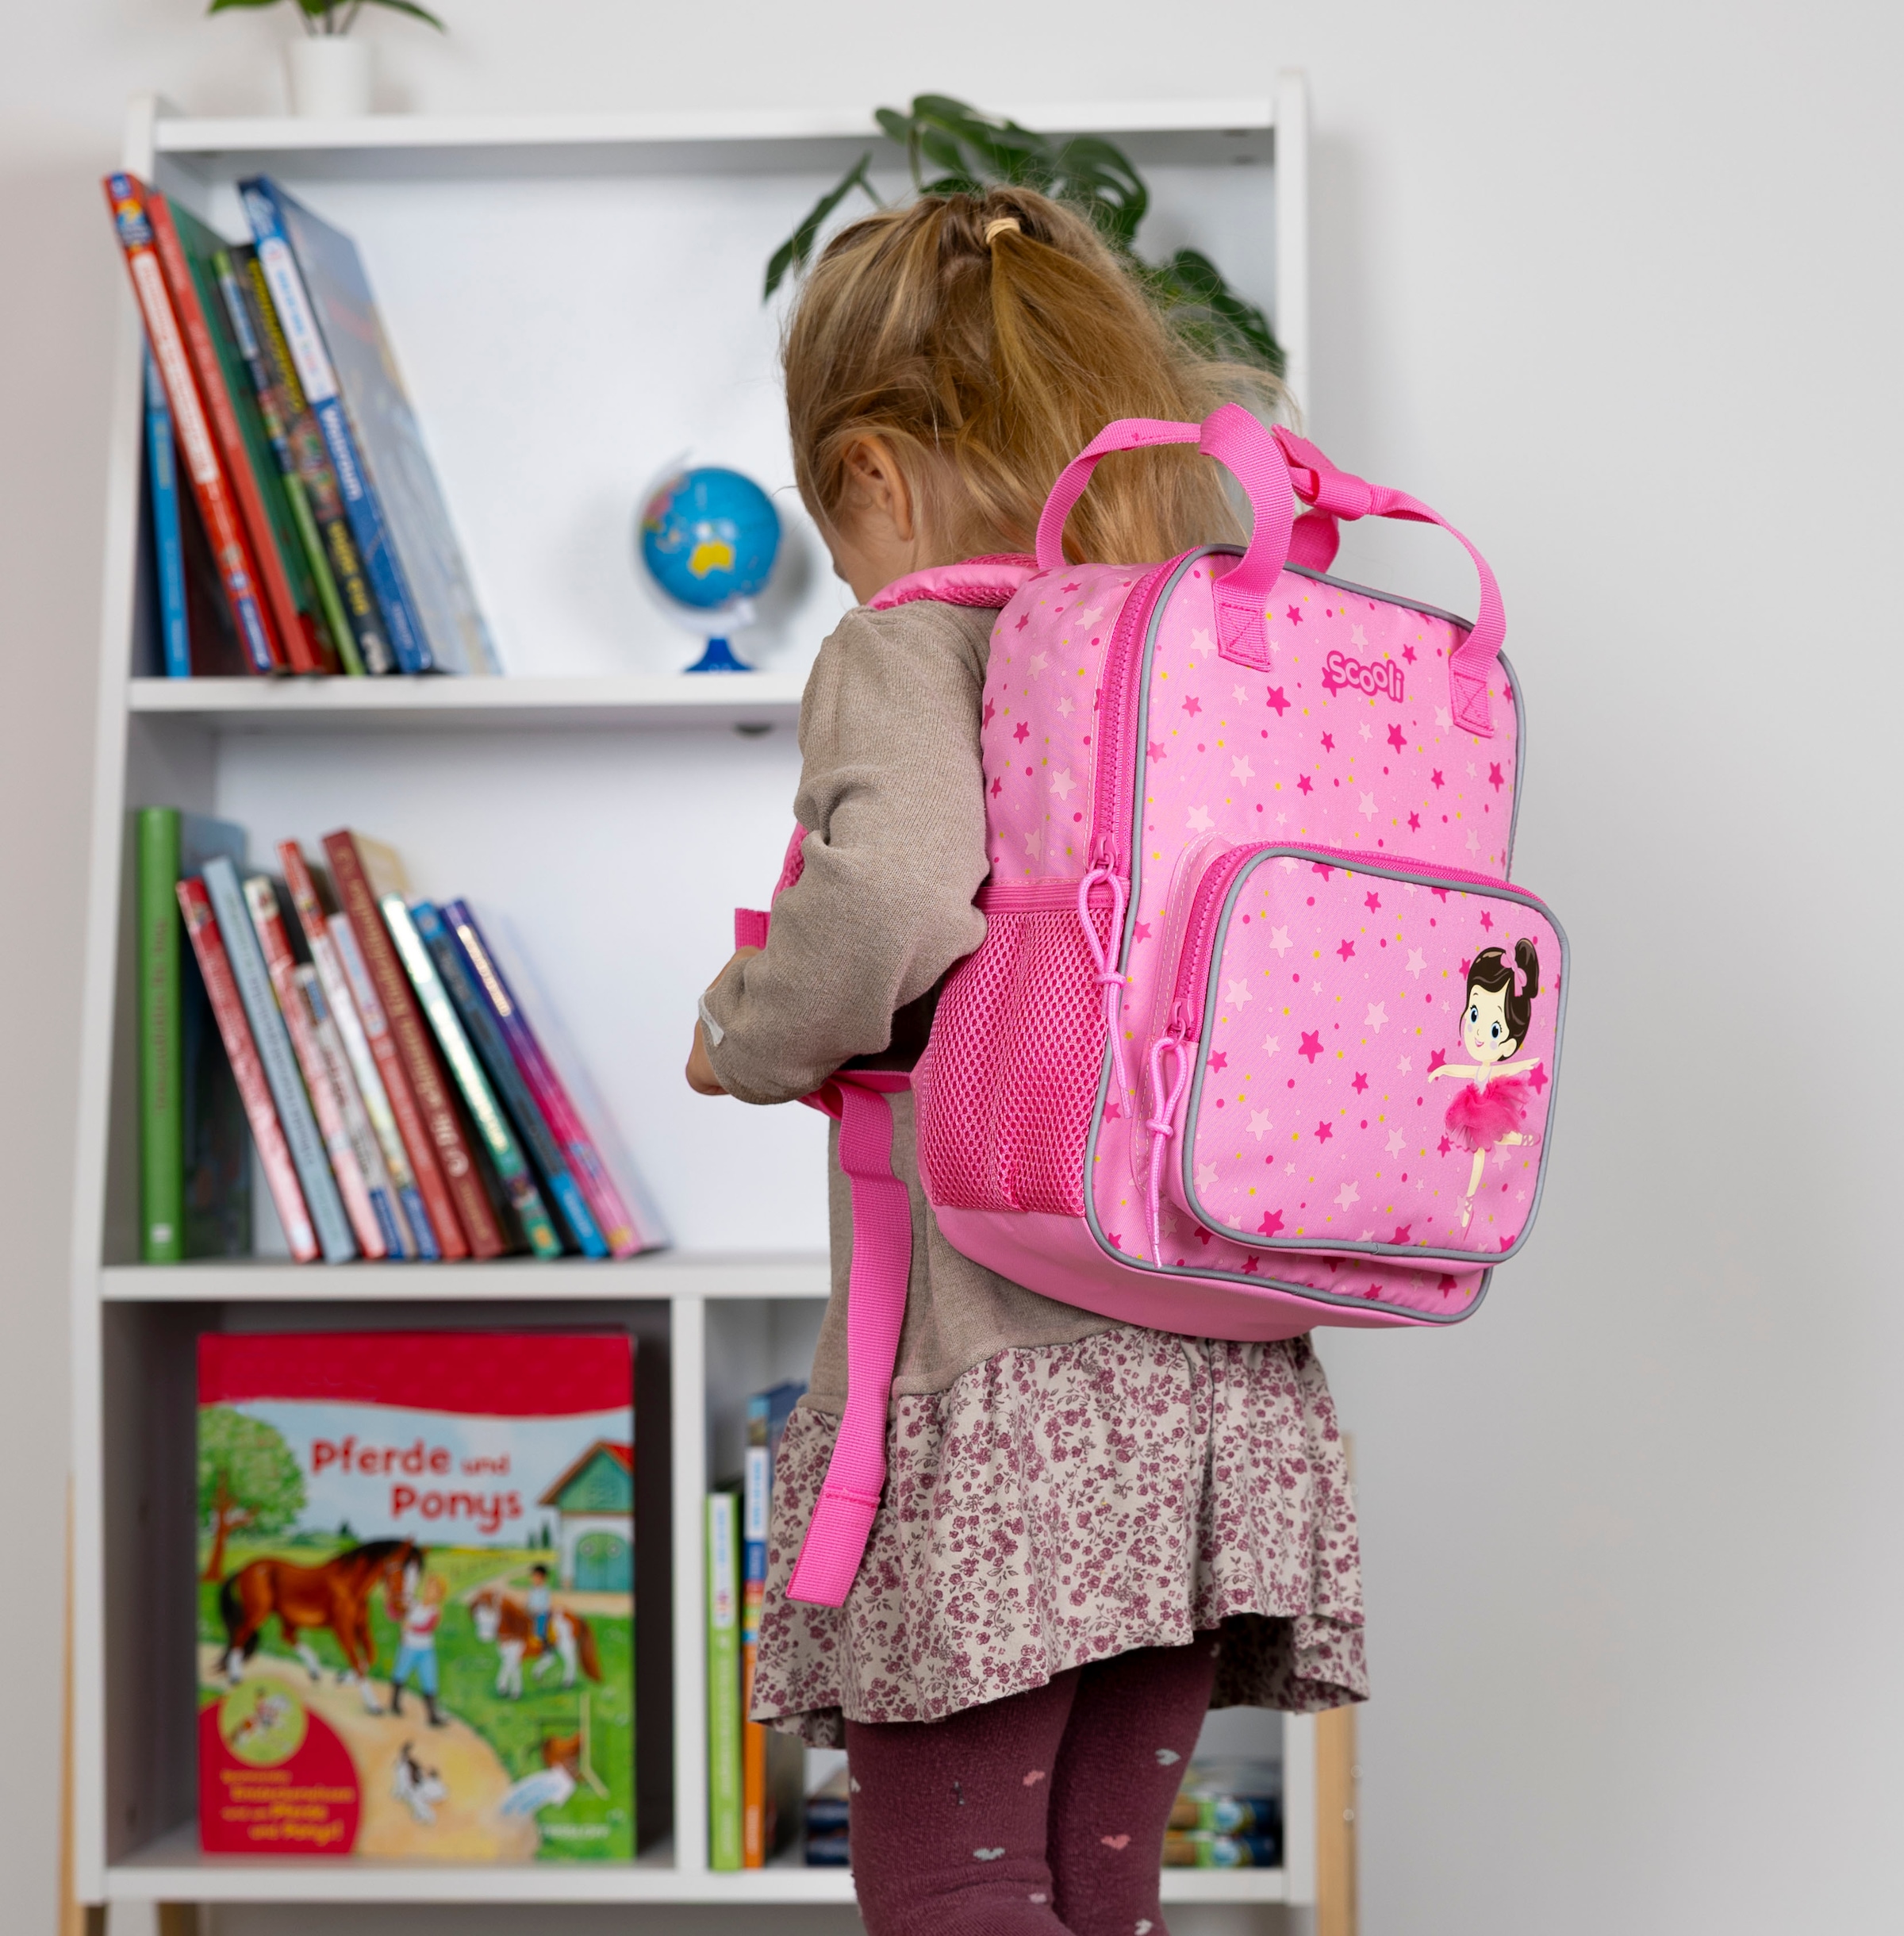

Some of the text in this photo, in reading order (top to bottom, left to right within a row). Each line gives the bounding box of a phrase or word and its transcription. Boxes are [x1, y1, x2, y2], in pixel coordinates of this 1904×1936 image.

[310, 1435, 511, 1477] Pferde und
[390, 1481, 524, 1535] Ponys
